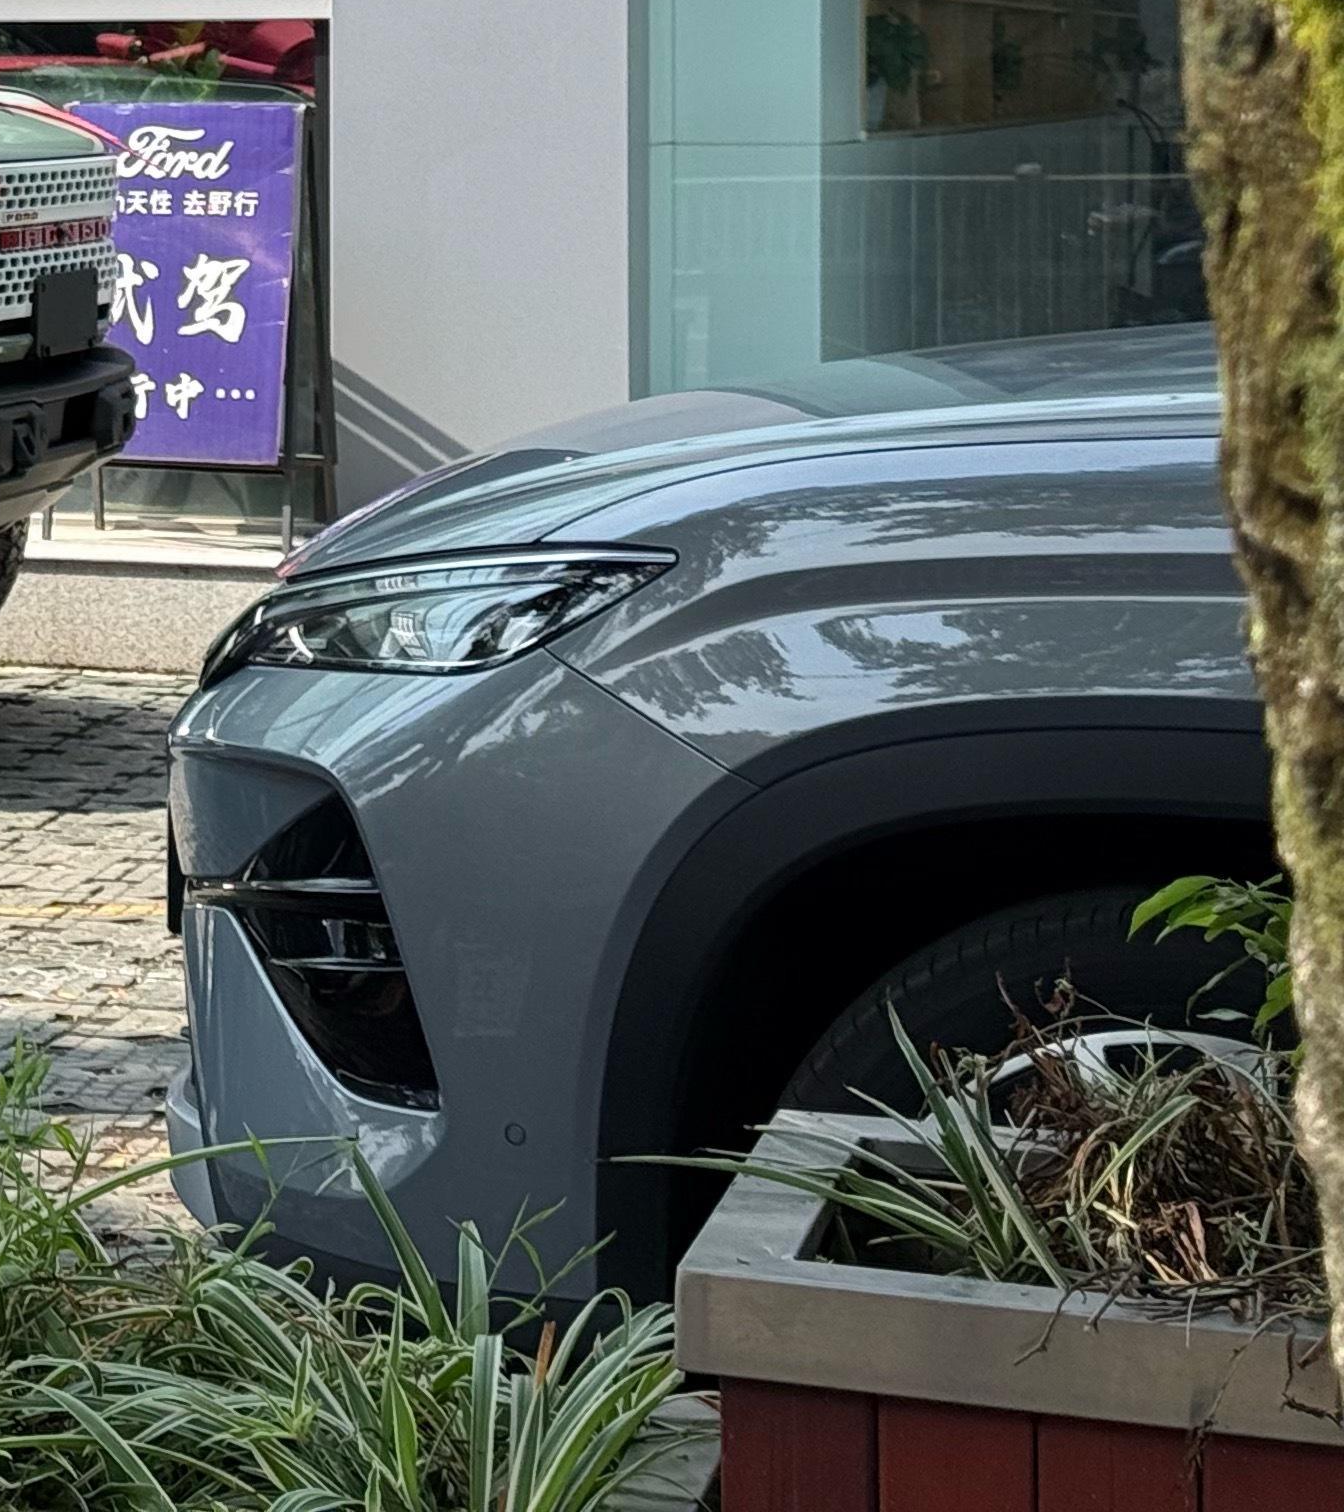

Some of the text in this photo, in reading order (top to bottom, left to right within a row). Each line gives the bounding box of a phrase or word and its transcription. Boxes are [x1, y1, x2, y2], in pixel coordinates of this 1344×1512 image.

[115, 125, 235, 180] Ford
[182, 189, 260, 217] 去野行
